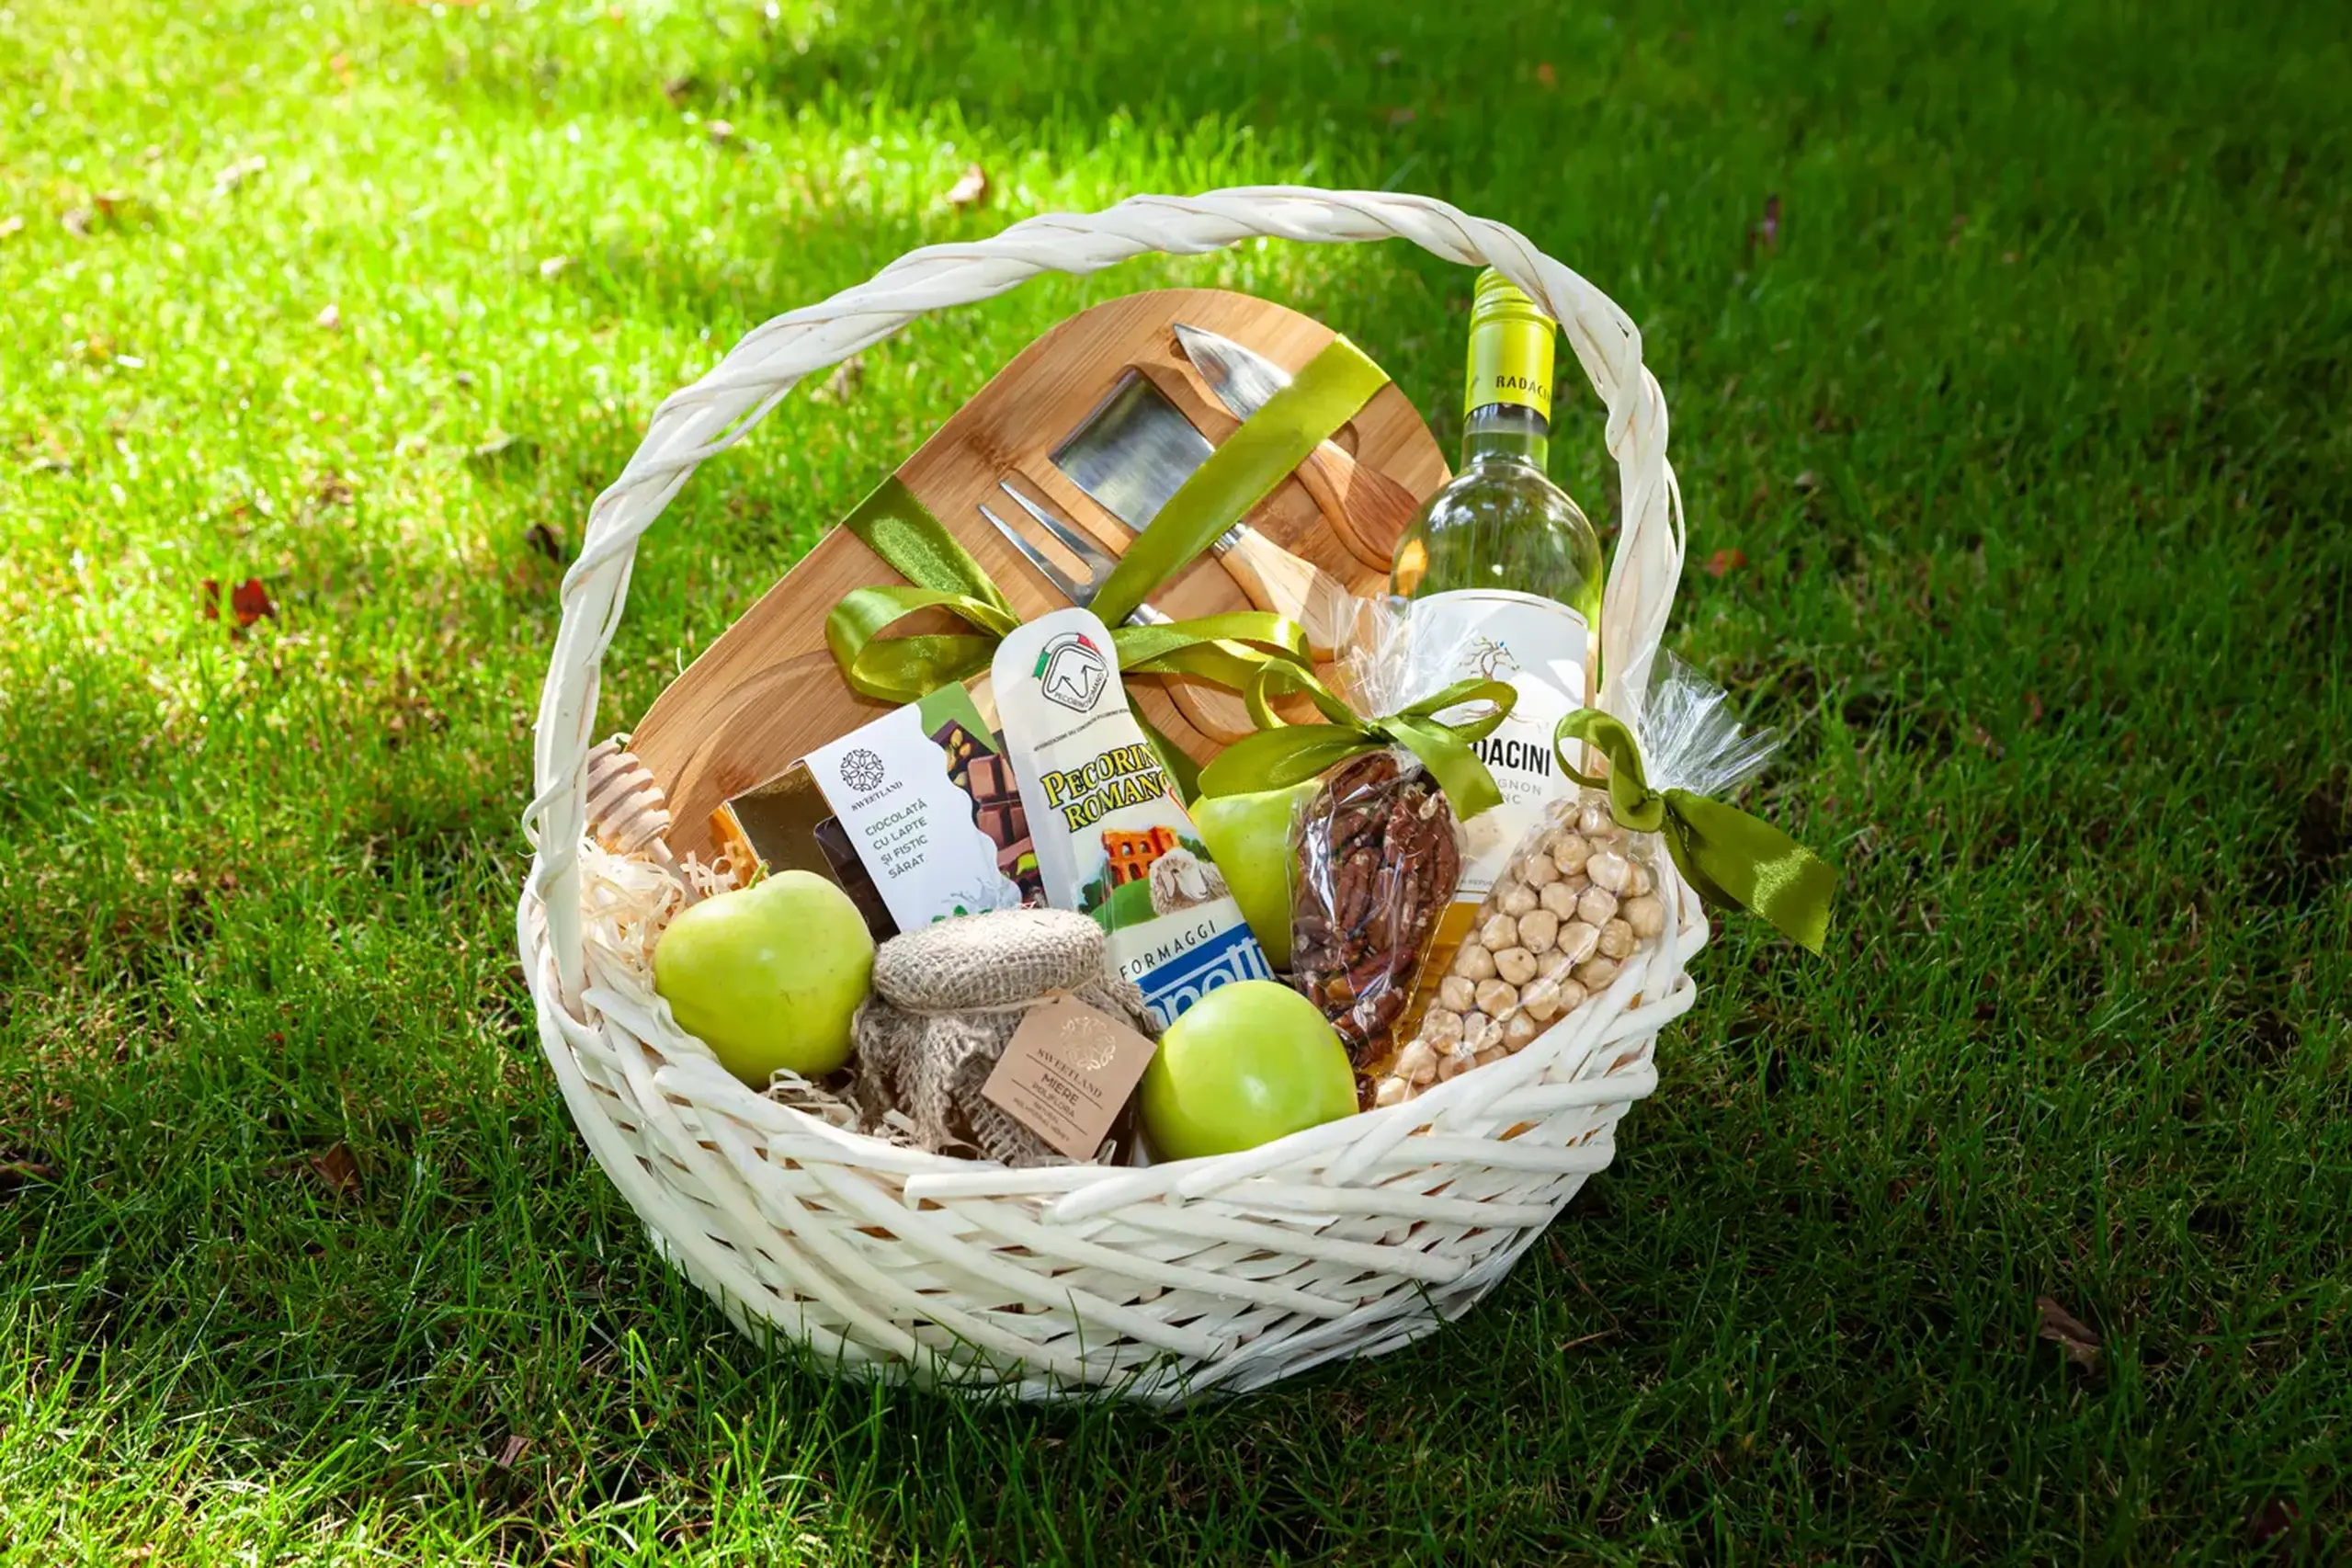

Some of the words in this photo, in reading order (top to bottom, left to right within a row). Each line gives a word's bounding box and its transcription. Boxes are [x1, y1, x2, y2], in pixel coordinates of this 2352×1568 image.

[1472, 738, 1551, 778] DACINI
[1040, 743, 1162, 810] PECORIN
[851, 781, 903, 812] SWEETLAND
[872, 835, 890, 850] CU
[892, 817, 928, 845] LAPTE
[893, 835, 928, 858] FISTIC
[1119, 920, 1219, 982] FORMAGGI
[1038, 1048, 1103, 1099] SWEETLAND
[1041, 1073, 1080, 1106] MIERE
